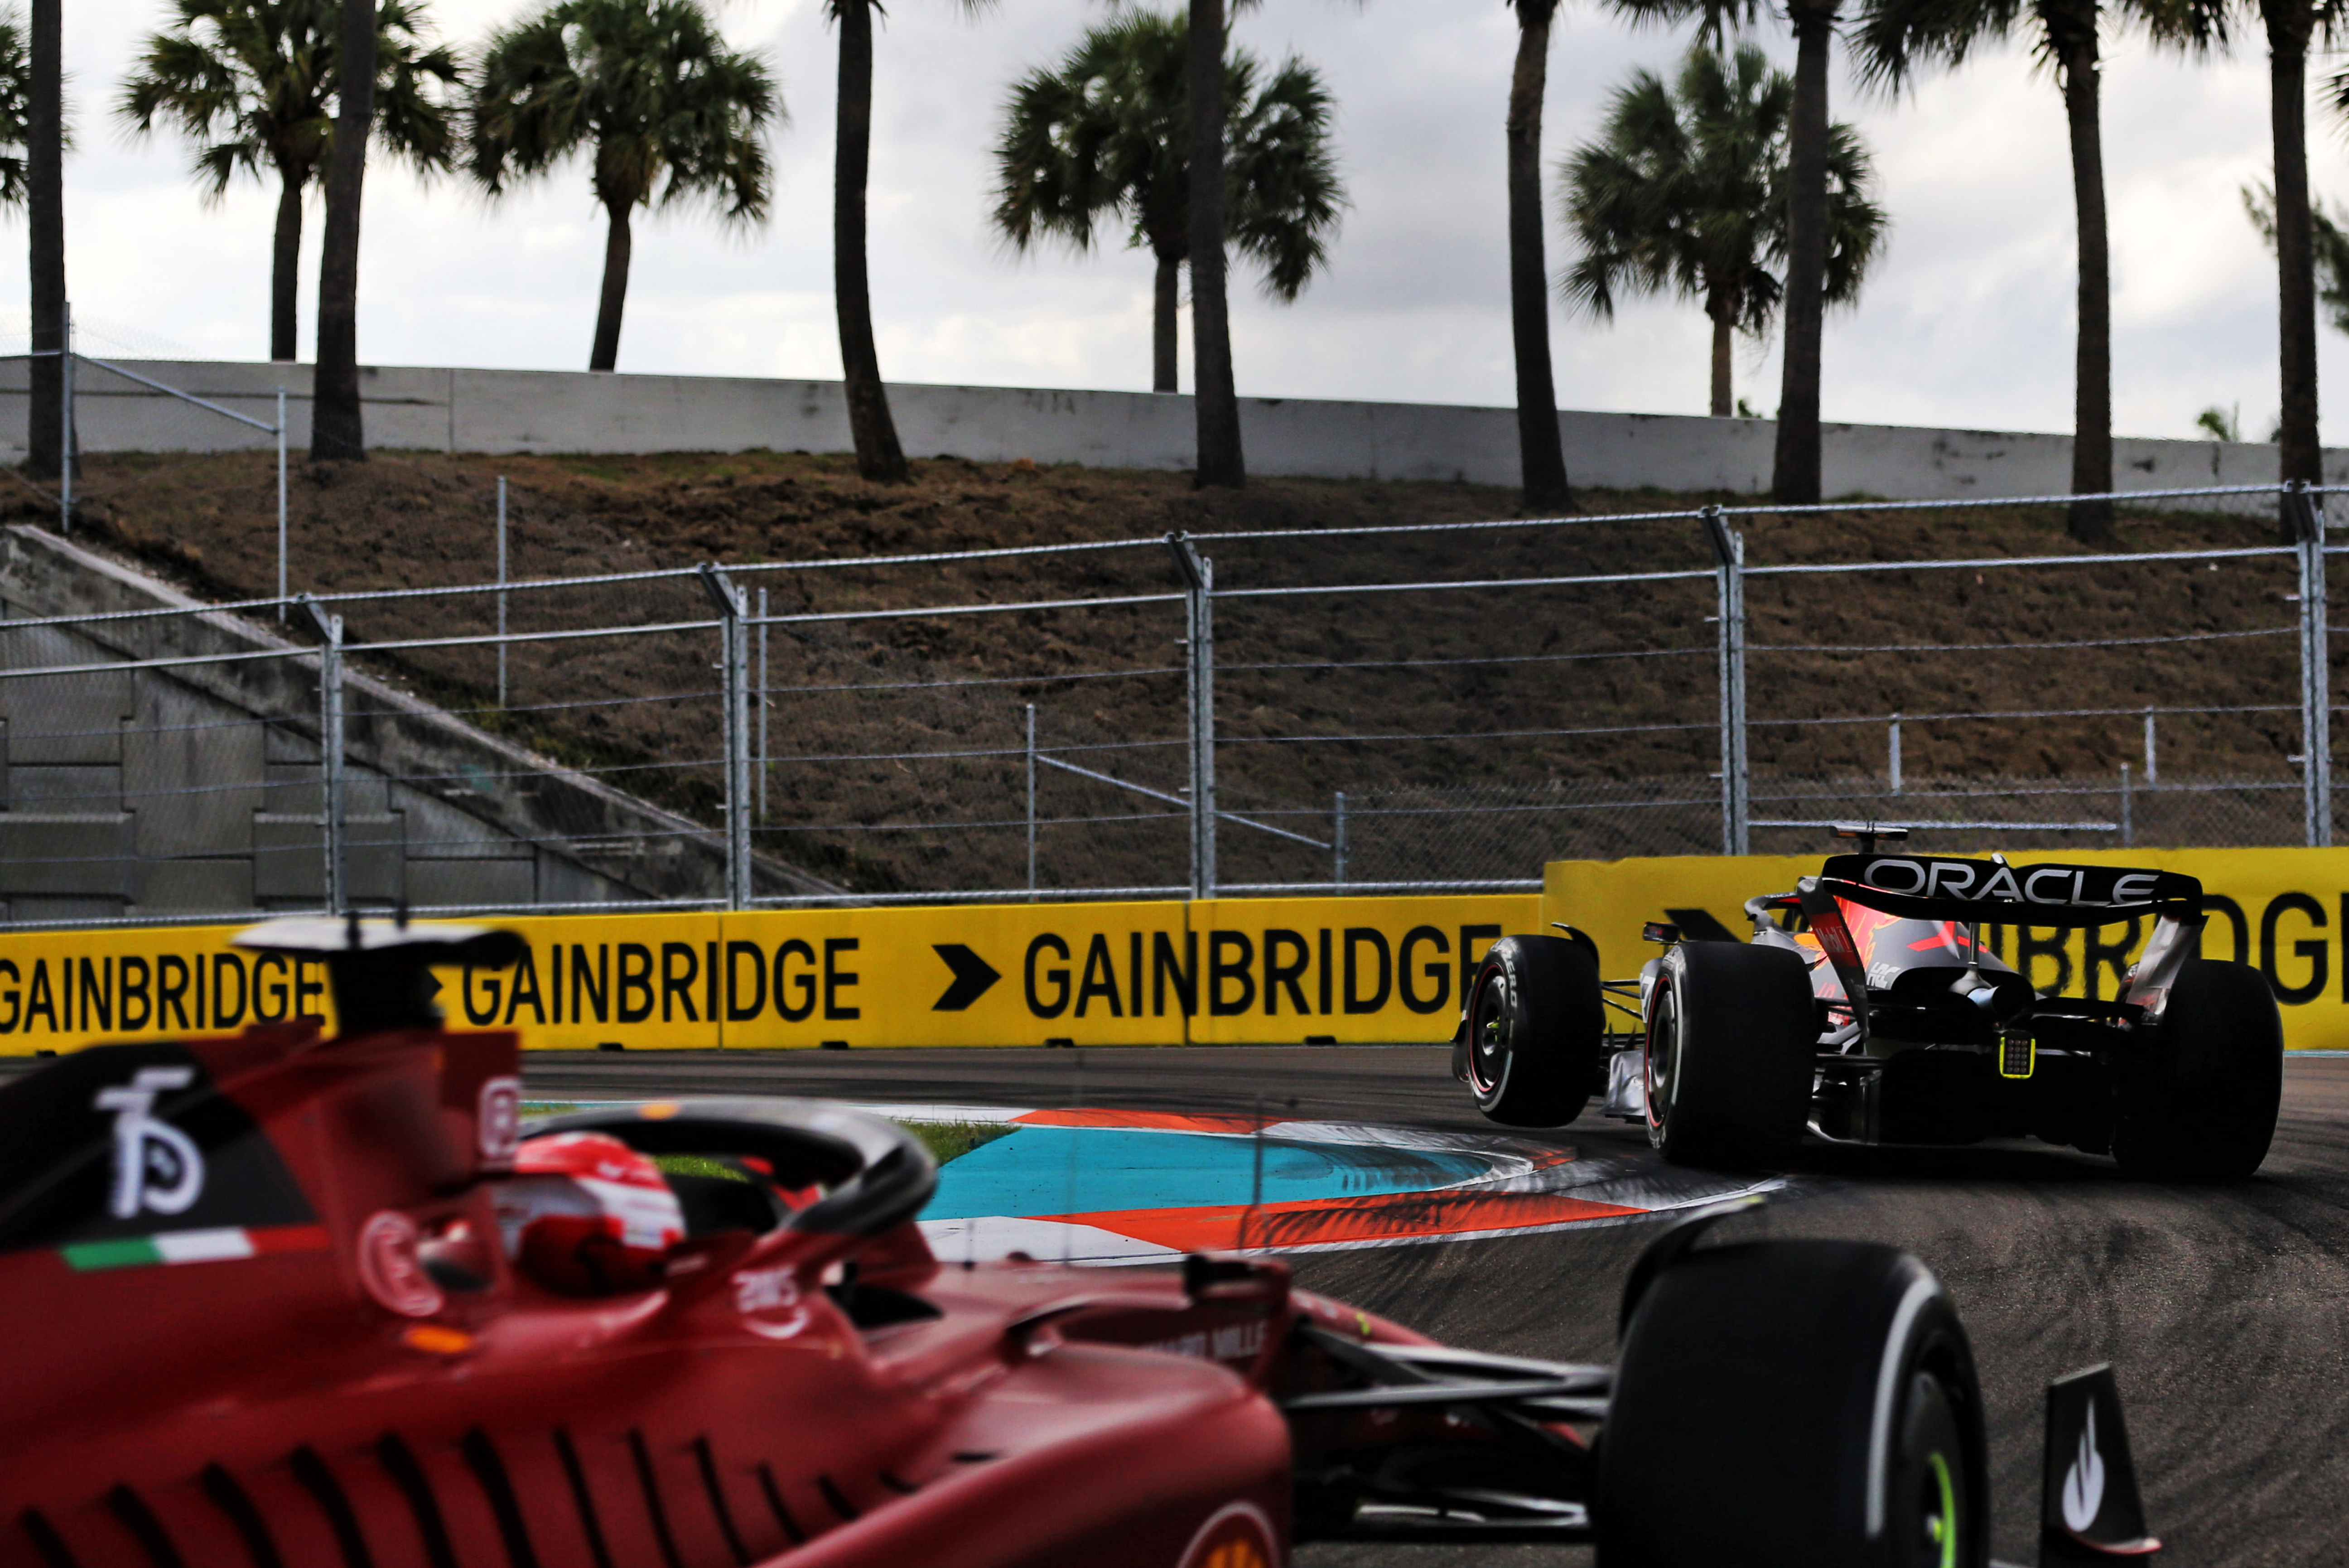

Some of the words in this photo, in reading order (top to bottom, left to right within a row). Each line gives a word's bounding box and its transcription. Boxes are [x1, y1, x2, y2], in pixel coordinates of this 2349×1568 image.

[1864, 859, 2159, 906] ORACLE
[0, 953, 325, 1034] GAINBRIDGE
[461, 938, 860, 1026] GAINBRIDGE
